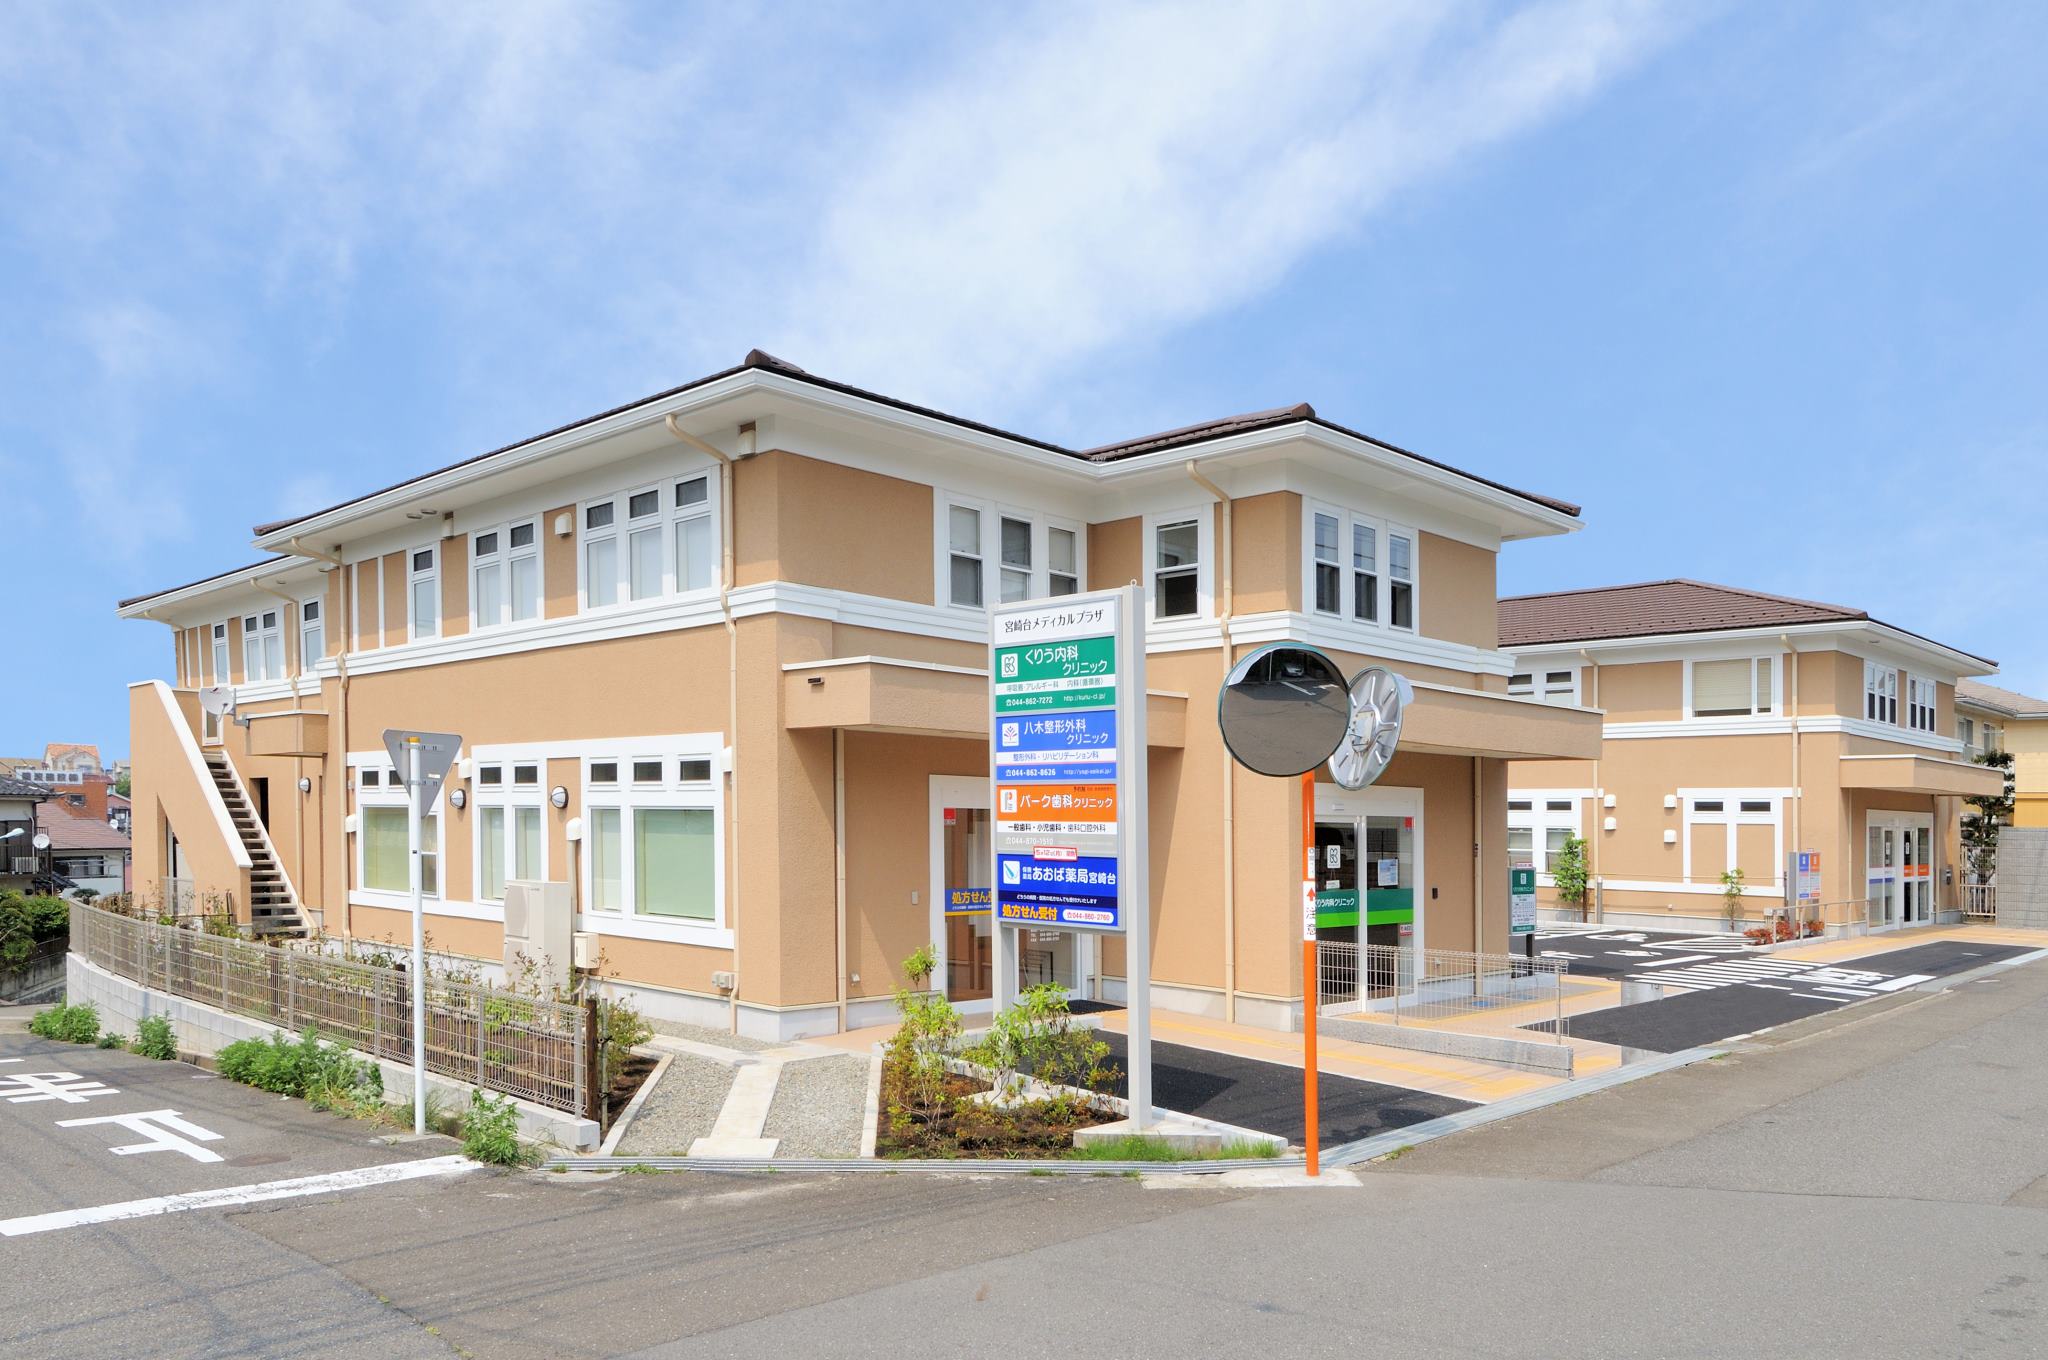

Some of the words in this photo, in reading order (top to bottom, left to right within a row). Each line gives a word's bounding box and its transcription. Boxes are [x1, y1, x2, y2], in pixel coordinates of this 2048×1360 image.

[1005, 609, 1104, 633] 宮崎台メディカルプラザ
[1025, 645, 1079, 665] くりう内科
[1062, 660, 1108, 676] クリニック
[1024, 718, 1086, 735] 八木整形外科
[1066, 732, 1109, 745] クリニック
[1020, 793, 1113, 809] パーク歯科クリニック
[1002, 904, 1058, 921] 処方せん受付
